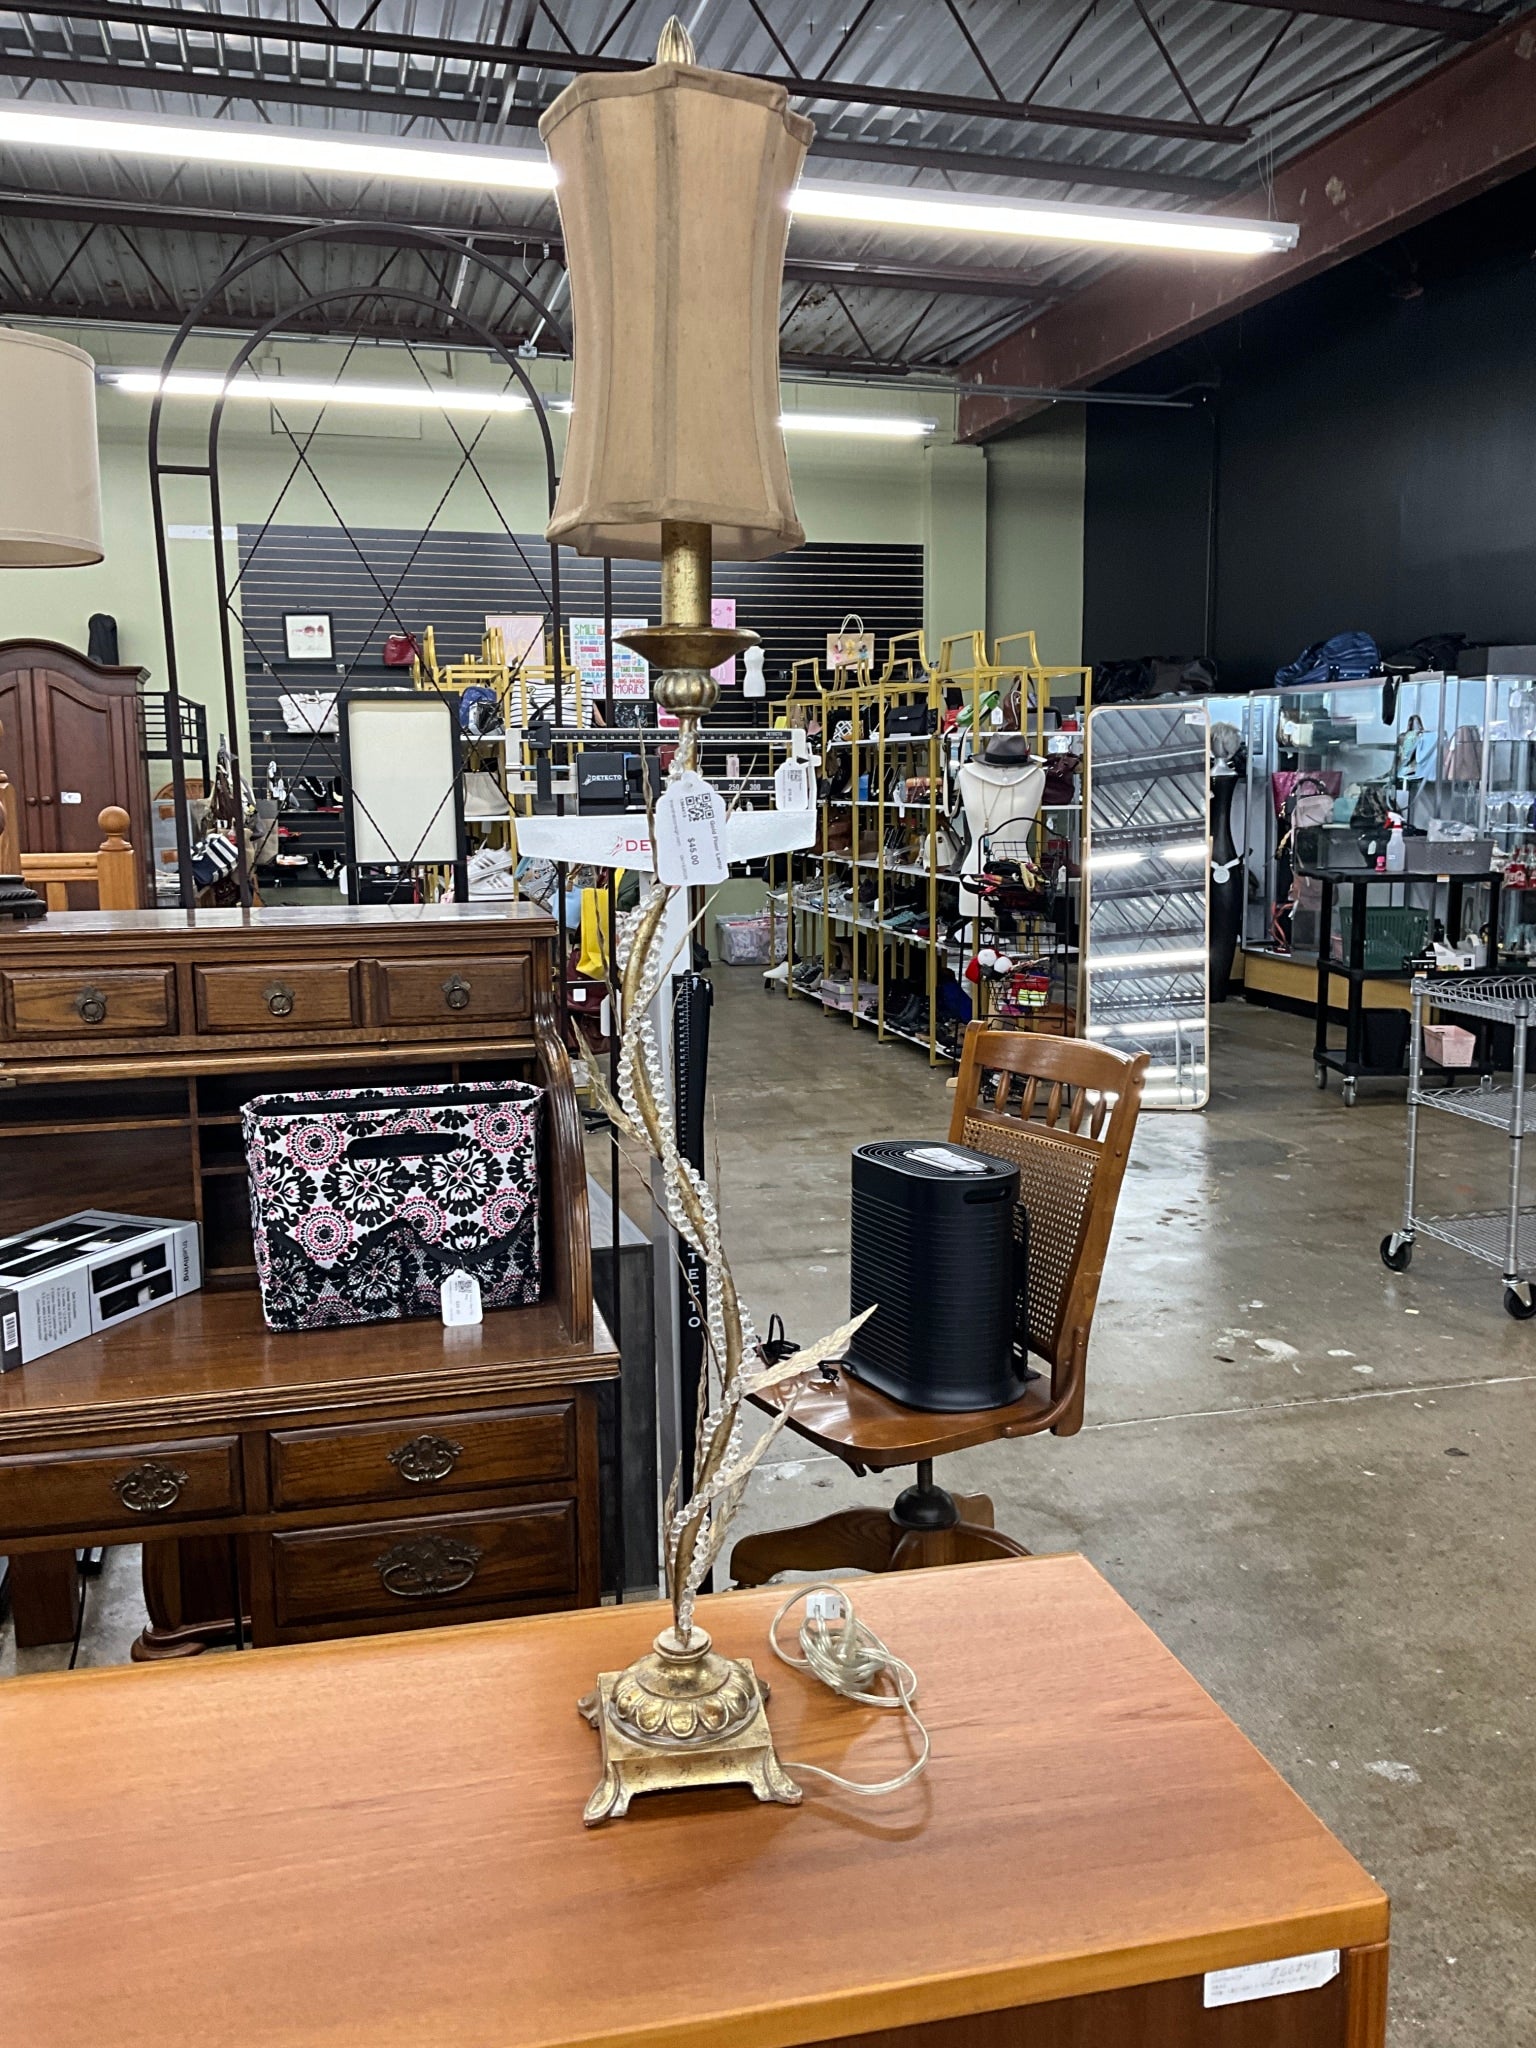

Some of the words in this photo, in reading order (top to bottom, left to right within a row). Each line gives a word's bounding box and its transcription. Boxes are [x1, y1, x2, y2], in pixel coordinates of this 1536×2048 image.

[574, 624, 596, 635] SMILE
[709, 820, 717, 835] Gold
[687, 837, 700, 866] $45.00
[712, 836, 720, 852] Floor
[715, 853, 723, 870] Lamp
